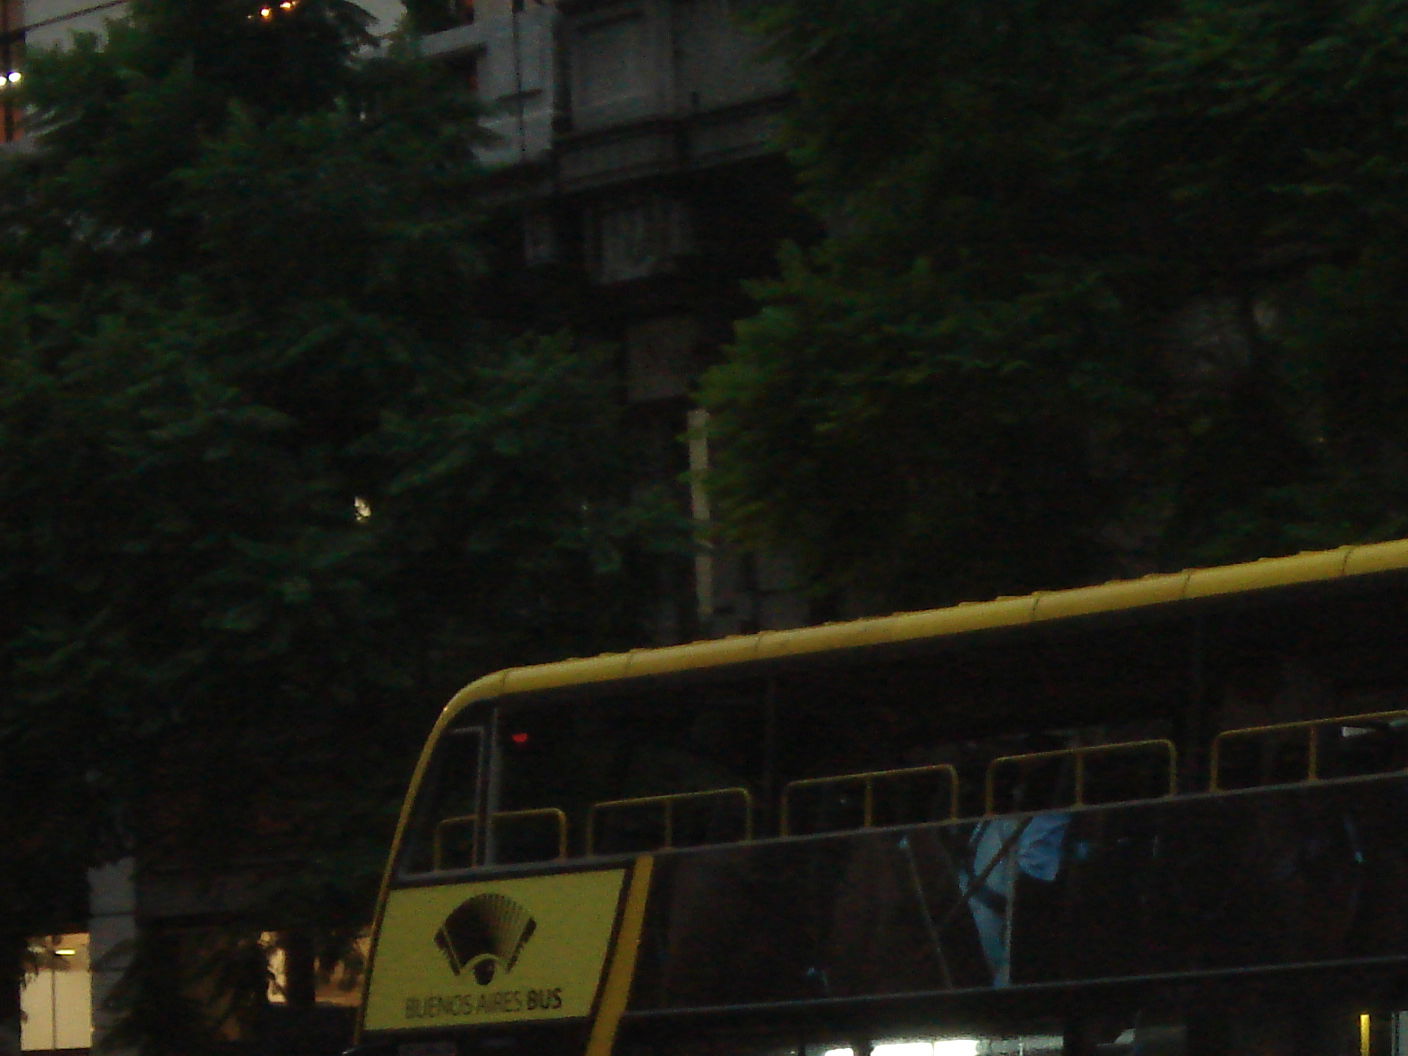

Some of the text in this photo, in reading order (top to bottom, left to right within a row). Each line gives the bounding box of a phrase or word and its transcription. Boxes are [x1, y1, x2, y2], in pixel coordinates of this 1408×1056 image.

[405, 988, 563, 1018] BUENOS AIRES BUS
